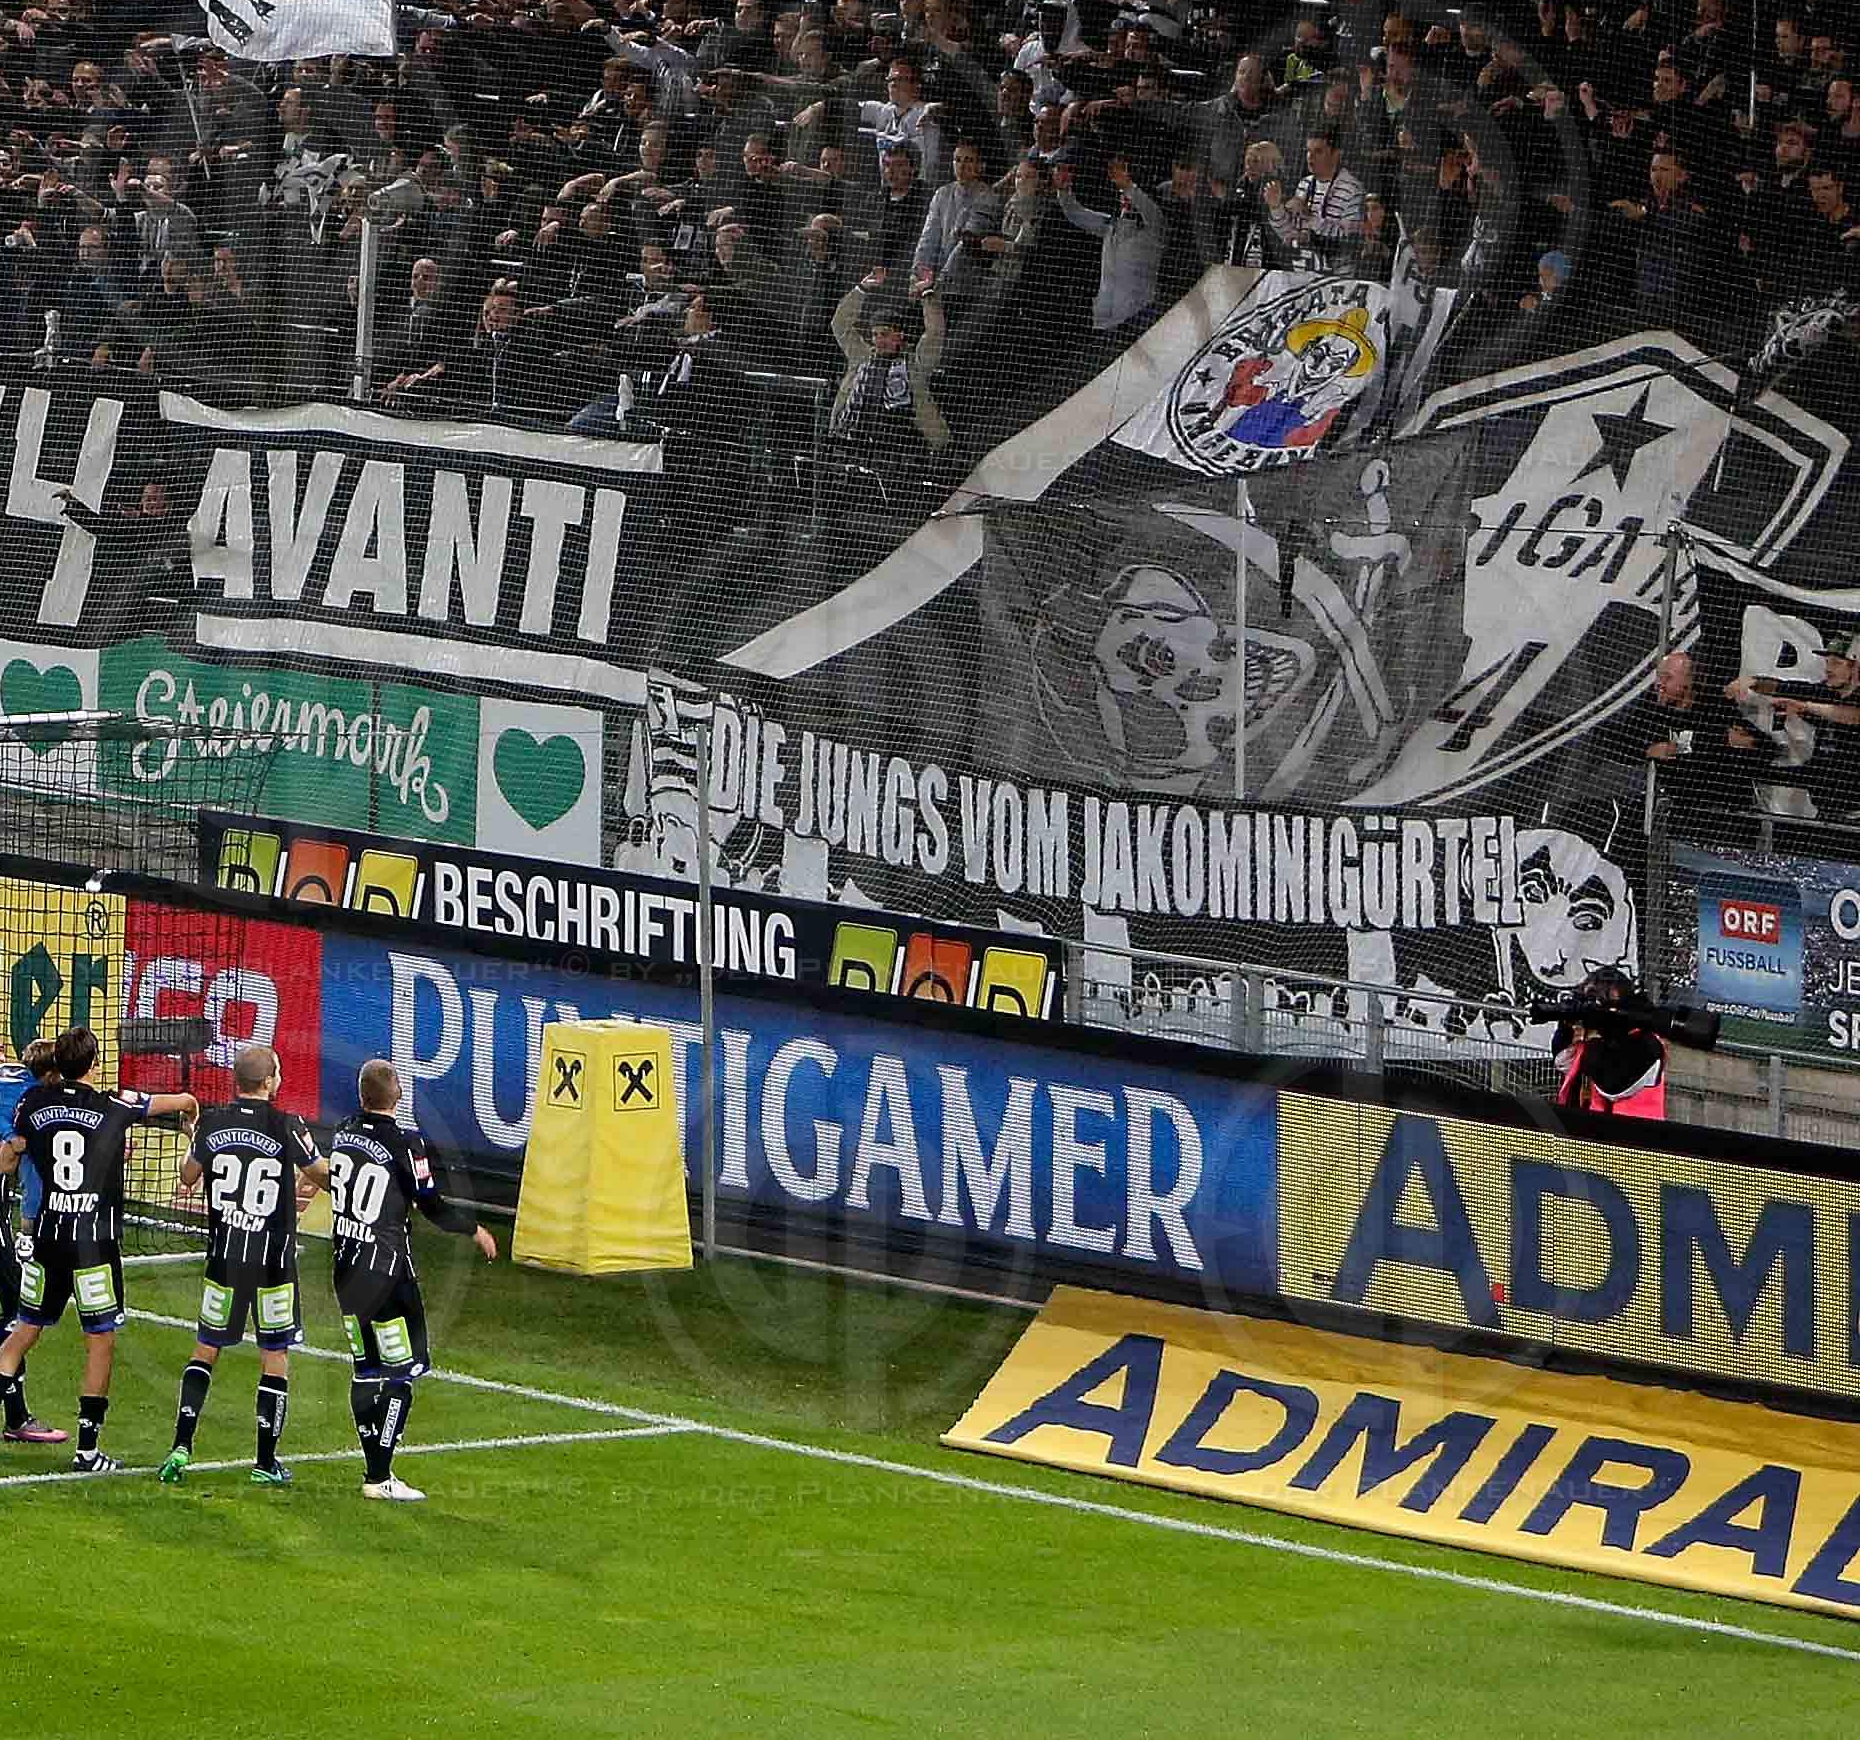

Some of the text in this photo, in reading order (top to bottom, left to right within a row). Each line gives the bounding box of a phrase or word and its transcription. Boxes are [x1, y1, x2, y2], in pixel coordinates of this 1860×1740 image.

[188, 448, 627, 643] AVANTI
[131, 668, 450, 823] Steiermark
[708, 706, 1527, 930] DIE JUNGS VOM JAKOMINIGÜRTEL
[434, 860, 796, 980] BESCHRIFTUNG
[1723, 906, 1777, 937] ORF
[1705, 946, 1789, 976] FUSSBALL
[209, 1130, 280, 1155] PUNTIGAMER
[388, 951, 1205, 1272] PUTIGAMER
[52, 1130, 85, 1191] 8
[211, 1153, 283, 1217] 26
[331, 1151, 391, 1225] 30
[48, 1191, 100, 1213] MATIC
